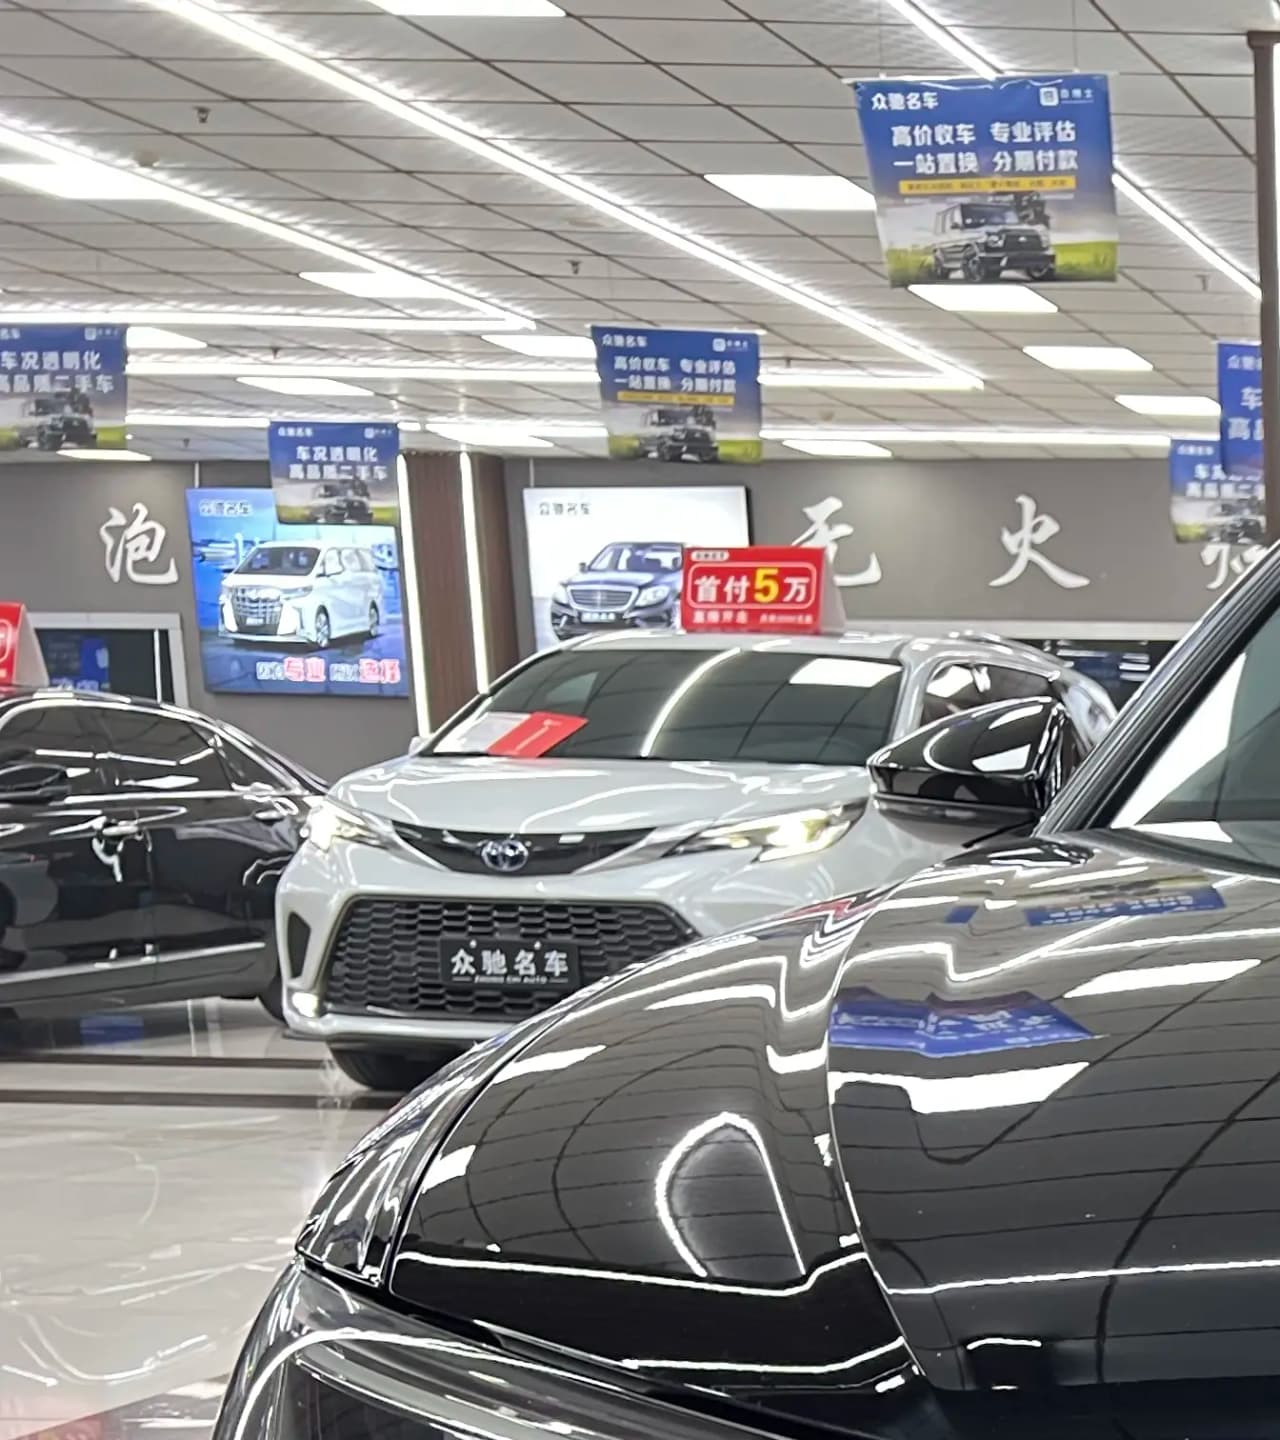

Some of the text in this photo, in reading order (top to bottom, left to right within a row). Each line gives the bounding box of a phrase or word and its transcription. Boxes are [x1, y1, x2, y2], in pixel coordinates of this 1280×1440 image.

[891, 120, 1077, 147] 高价收车 专业评估
[893, 150, 1079, 174] 一站置换 分期付款
[99, 502, 179, 584] 泡
[694, 566, 811, 604] 首付5万
[451, 948, 569, 976] 众驰名车
